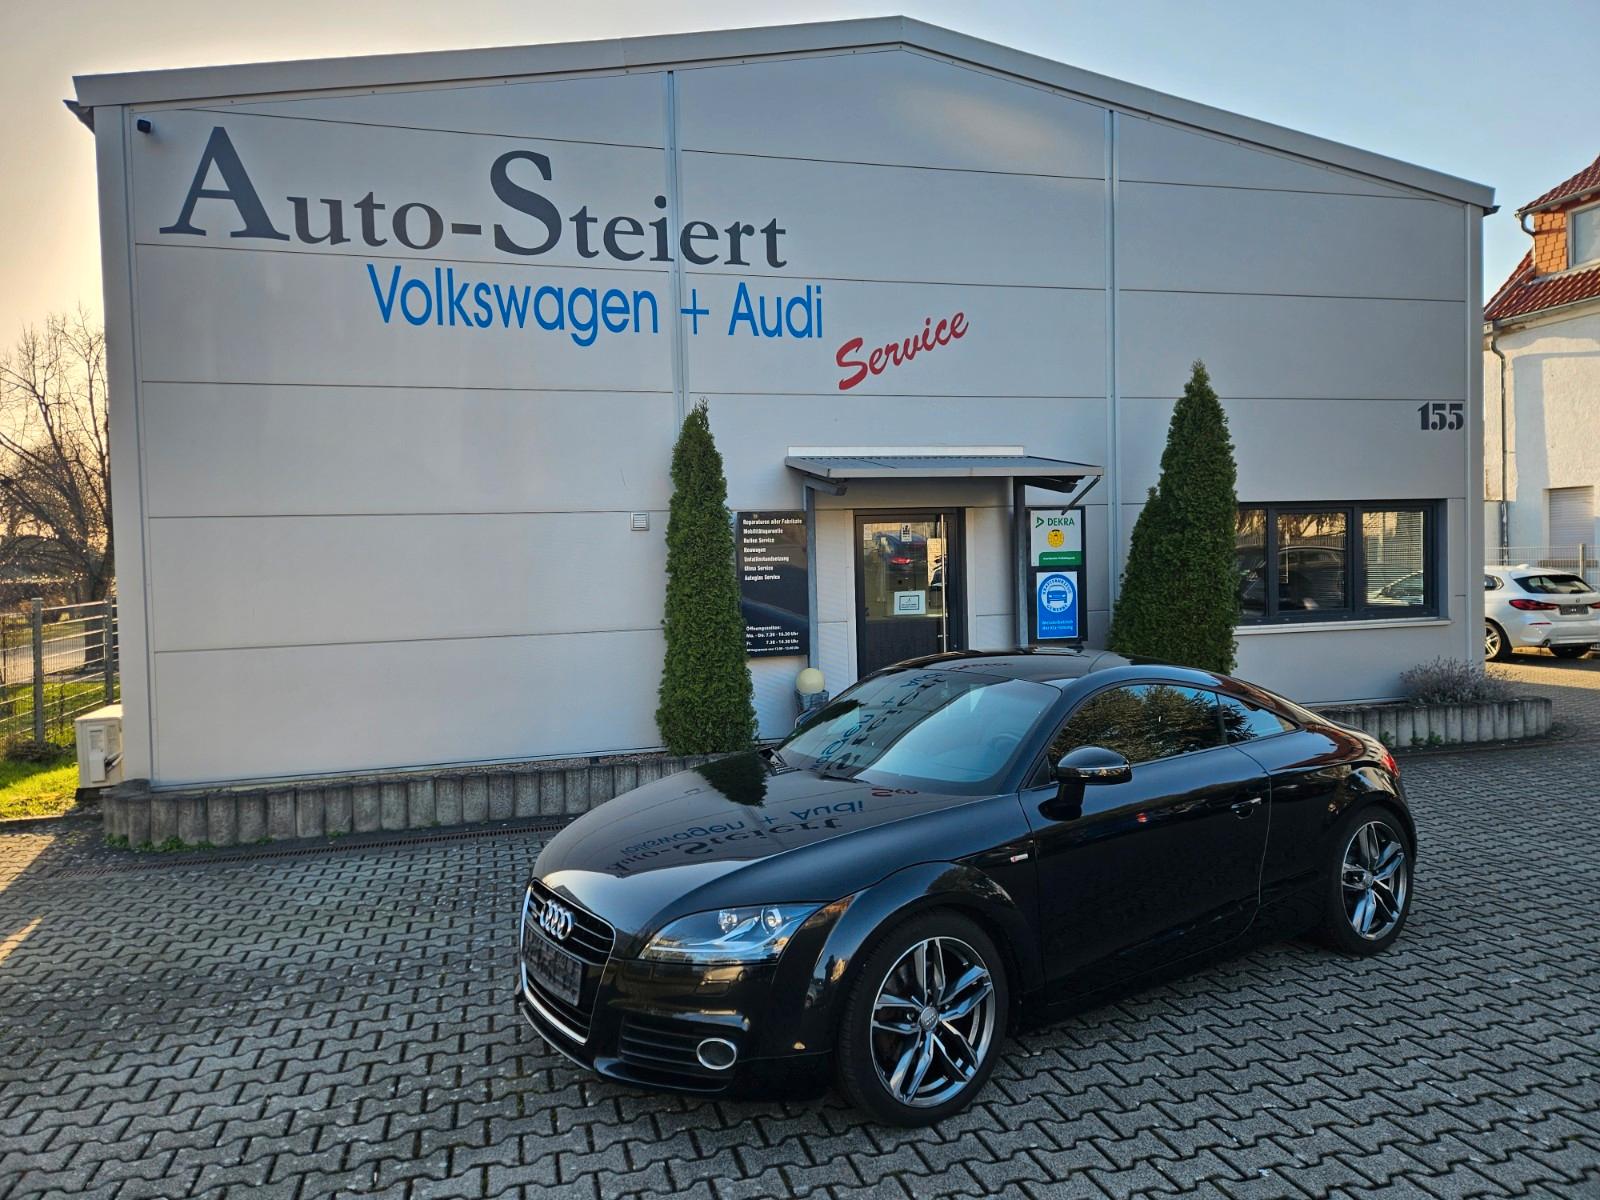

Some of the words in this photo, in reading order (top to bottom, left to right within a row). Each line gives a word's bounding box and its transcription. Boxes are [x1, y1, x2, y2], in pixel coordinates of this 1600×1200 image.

[159, 126, 787, 268] Auto-Steiert
[366, 264, 659, 347] Volkswagen
[680, 288, 710, 335] +
[728, 281, 823, 338] Audi
[836, 312, 969, 390] Service
[1417, 401, 1464, 431] 155
[1047, 517, 1075, 526] DEKRA
